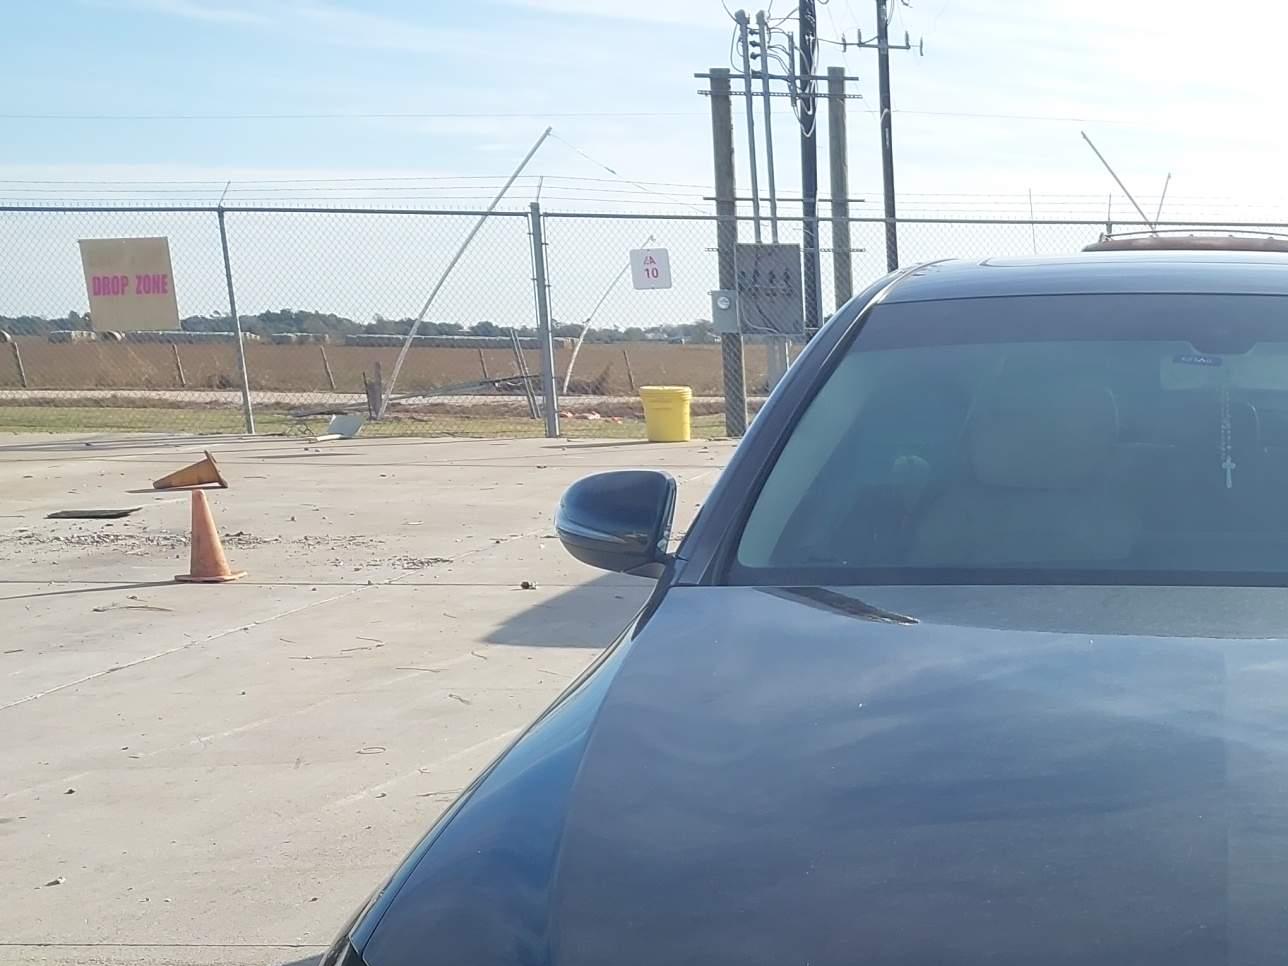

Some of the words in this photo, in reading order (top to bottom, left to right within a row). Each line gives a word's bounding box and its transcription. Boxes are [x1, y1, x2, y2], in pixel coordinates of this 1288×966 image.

[644, 267, 659, 279] 10
[92, 275, 129, 296] DROP
[135, 274, 169, 295] ZONE
